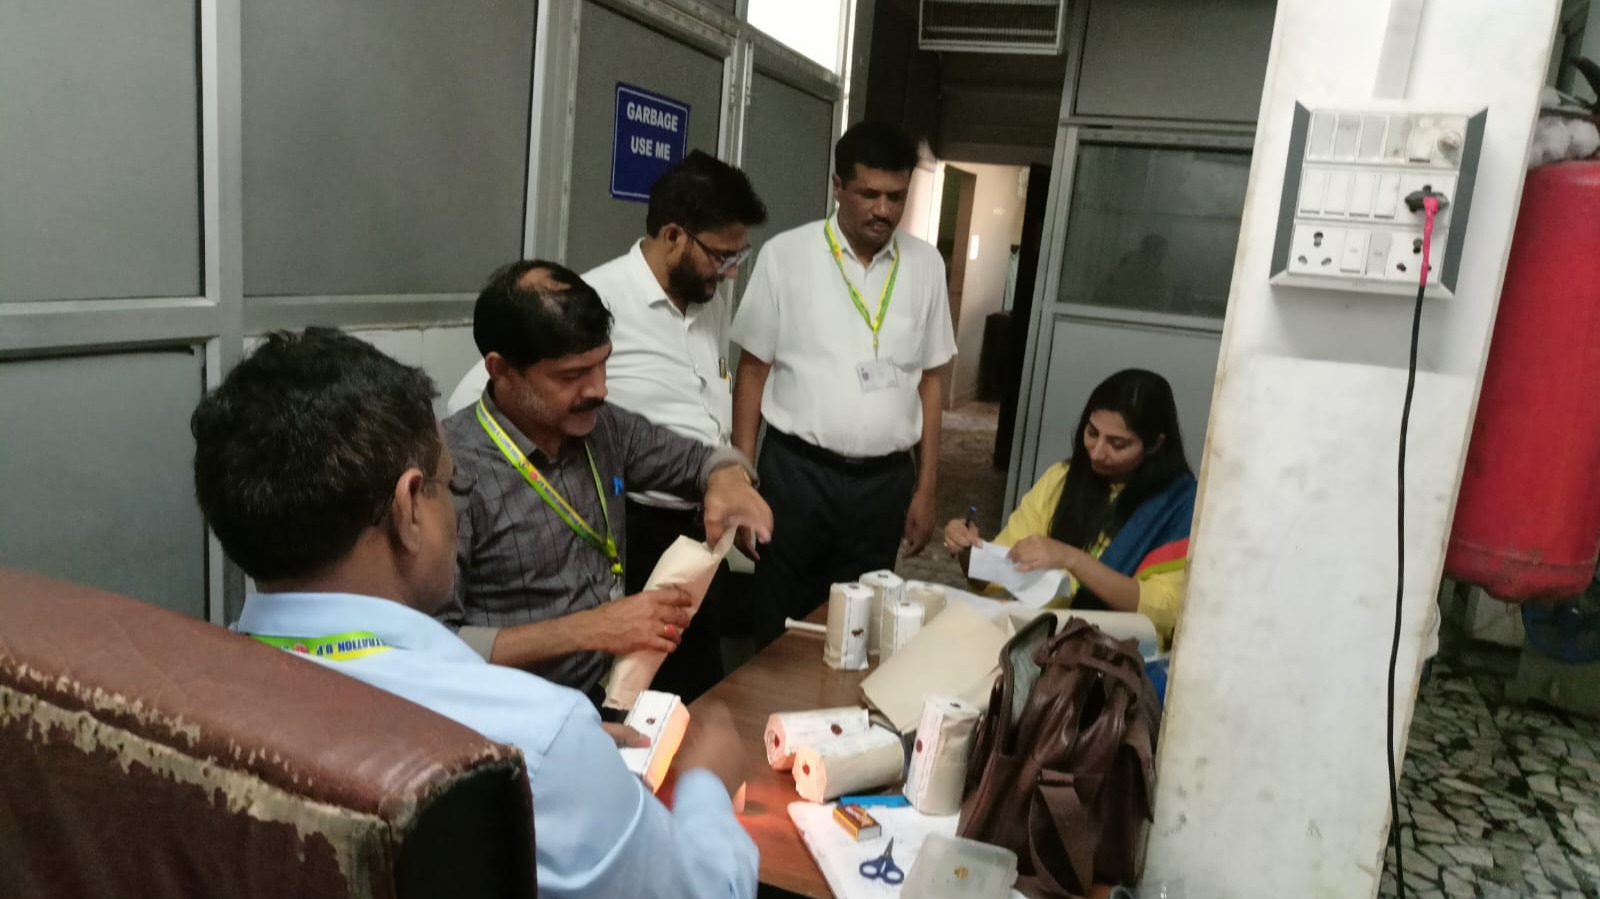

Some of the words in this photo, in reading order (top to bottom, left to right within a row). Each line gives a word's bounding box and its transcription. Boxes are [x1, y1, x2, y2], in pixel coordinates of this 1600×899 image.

[627, 102, 679, 132] GARBAGE
[630, 135, 653, 157] USE
[655, 142, 671, 161] ME
